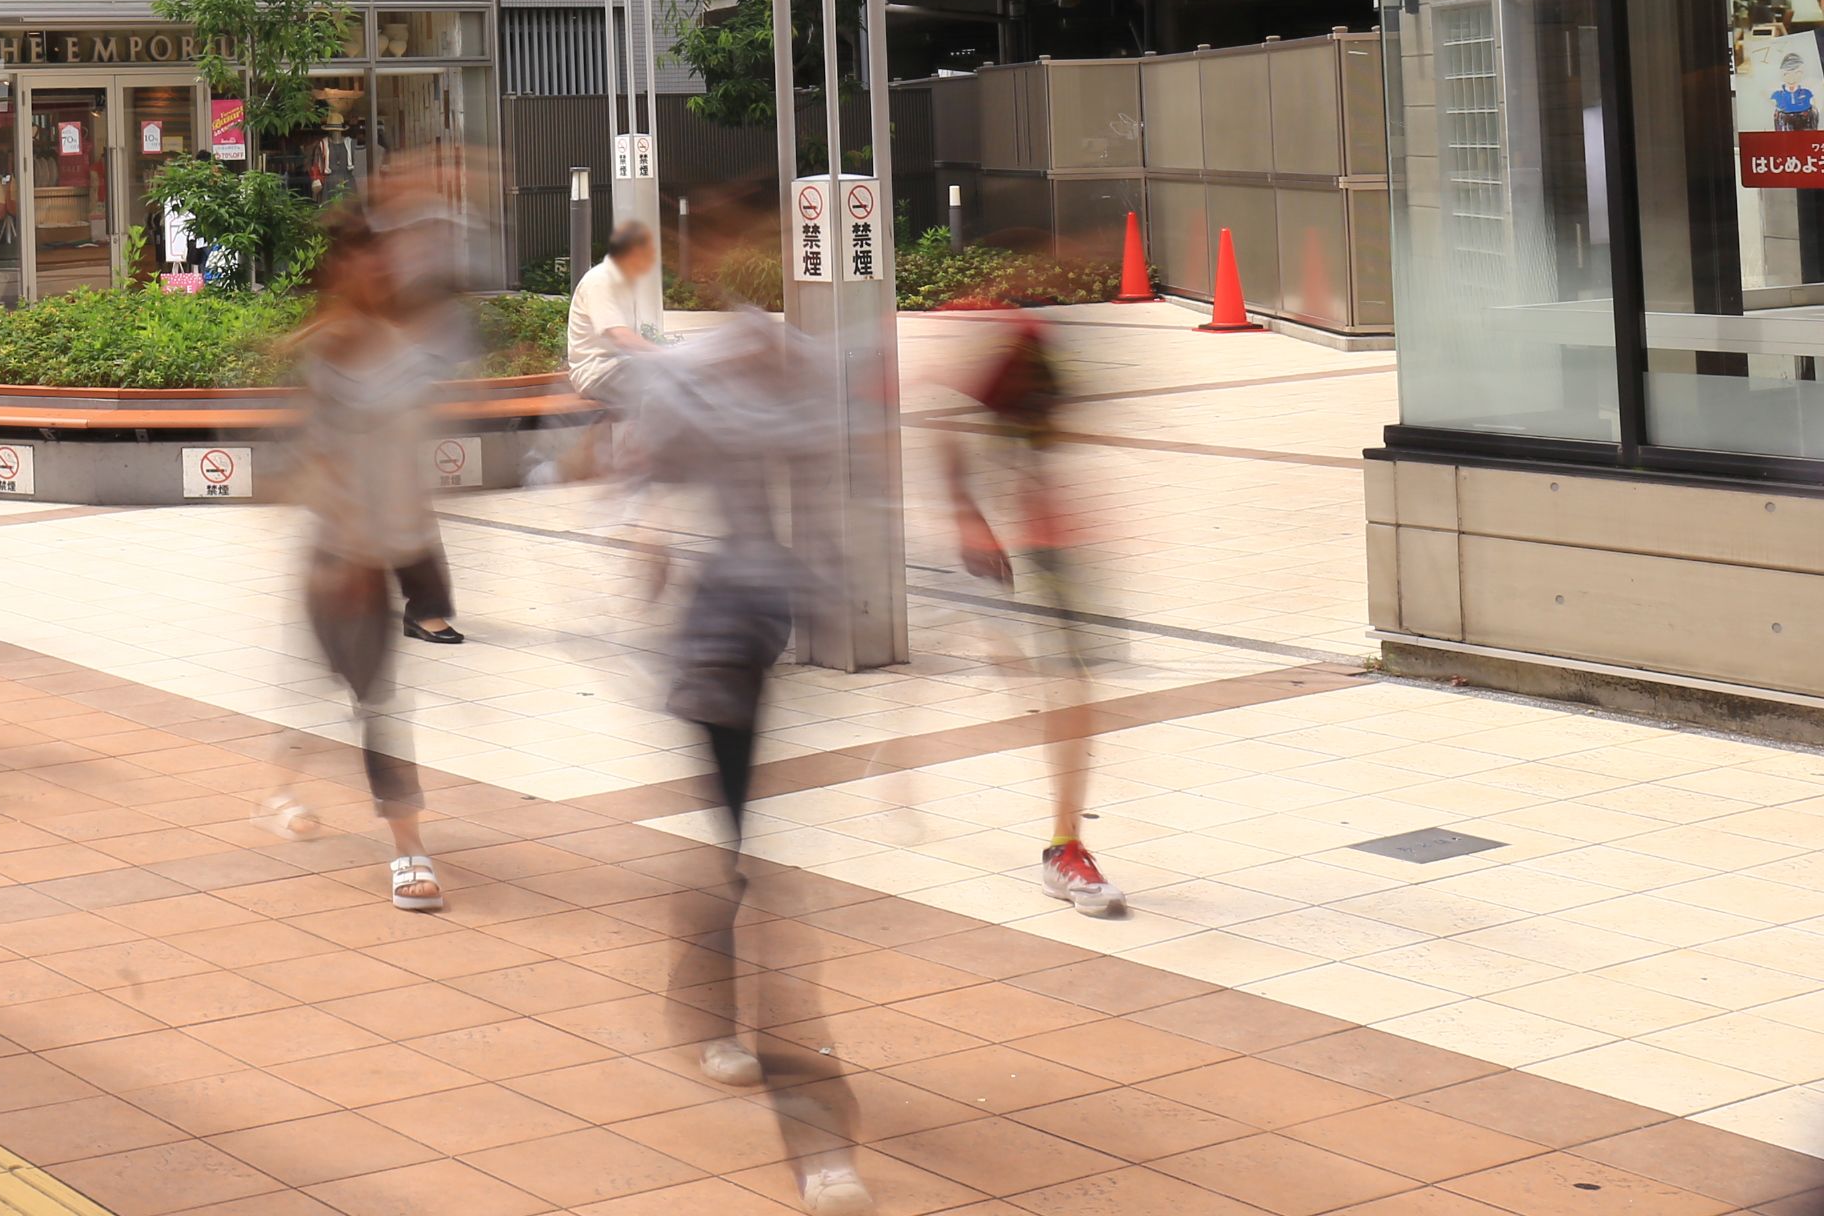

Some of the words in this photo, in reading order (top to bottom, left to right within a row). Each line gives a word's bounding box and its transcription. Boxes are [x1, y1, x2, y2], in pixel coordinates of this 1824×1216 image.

[639, 154, 649, 176] 禁煙
[802, 223, 822, 277] 禁煙
[852, 222, 873, 276] 禁煙
[205, 484, 230, 496] 禁煙
